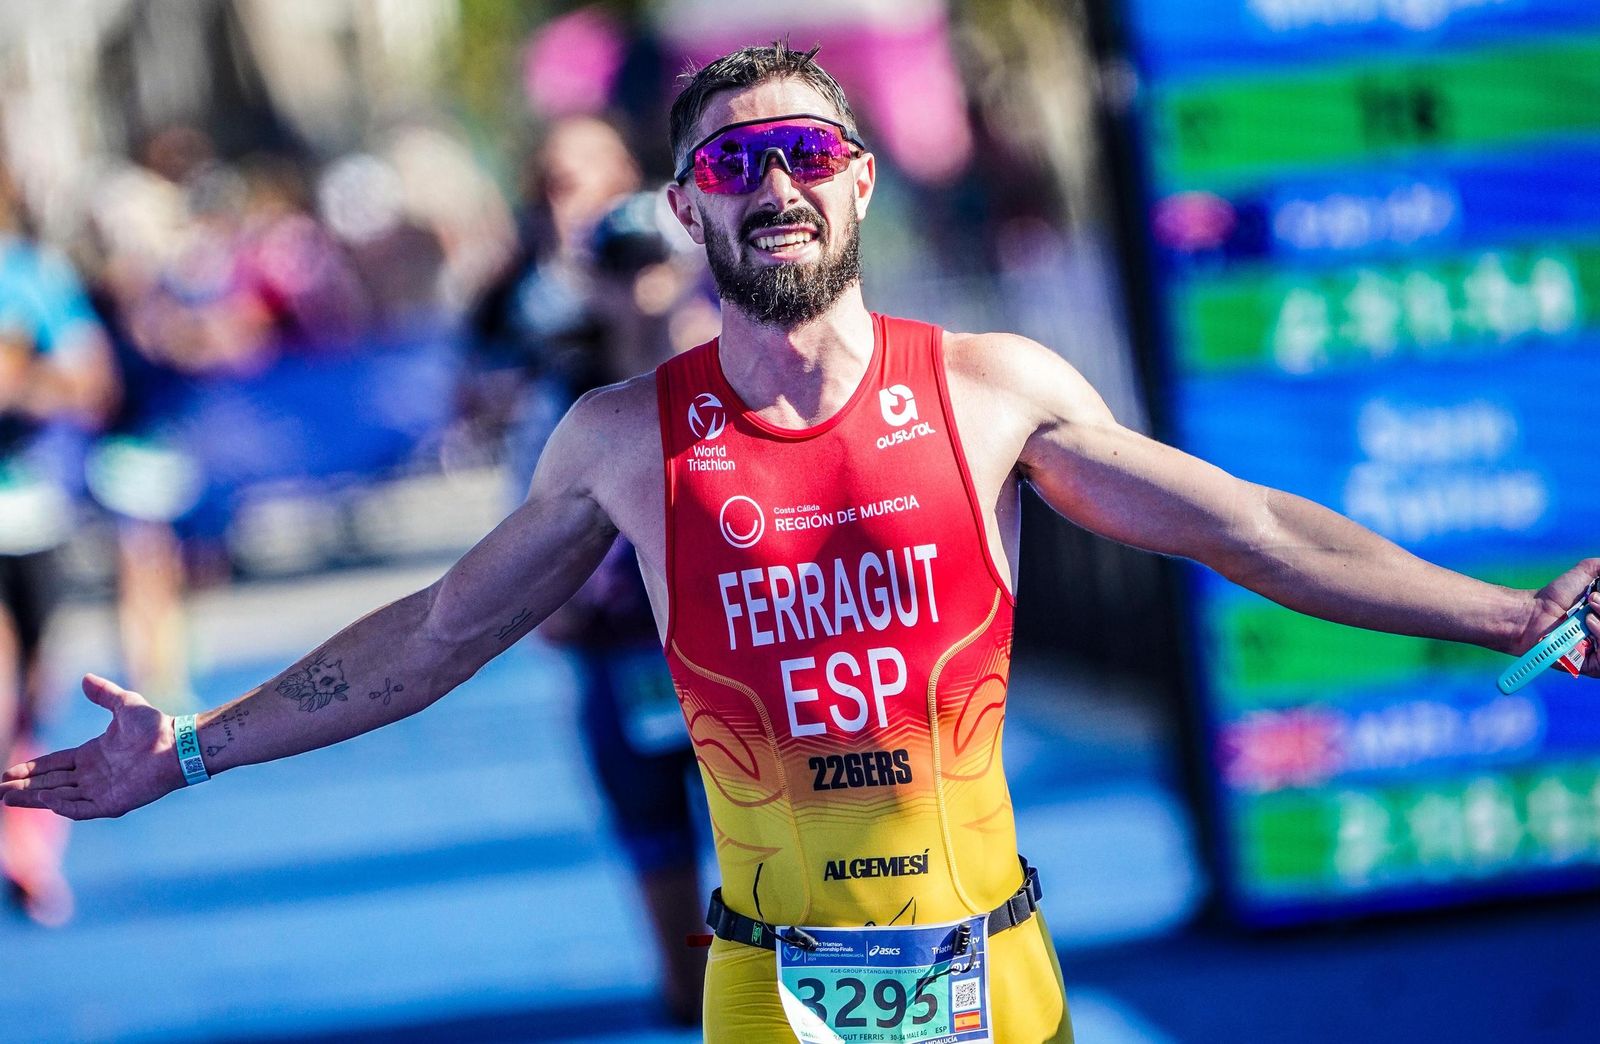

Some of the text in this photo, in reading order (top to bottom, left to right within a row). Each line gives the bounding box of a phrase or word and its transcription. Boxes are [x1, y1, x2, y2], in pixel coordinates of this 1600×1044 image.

[876, 421, 936, 449] austral
[687, 459, 736, 471] Triathlon
[693, 445, 727, 457] World
[773, 504, 820, 515] Costa Cálida
[775, 495, 920, 531] REGIÓN DE MURCIA
[718, 543, 939, 650] FERRAGUT
[780, 647, 908, 738] ESP
[179, 725, 196, 755] 3295
[808, 748, 912, 791] 226ERS
[824, 848, 930, 881] ALGEMESÍ
[879, 947, 900, 955] asics
[797, 977, 938, 1028] 3295
